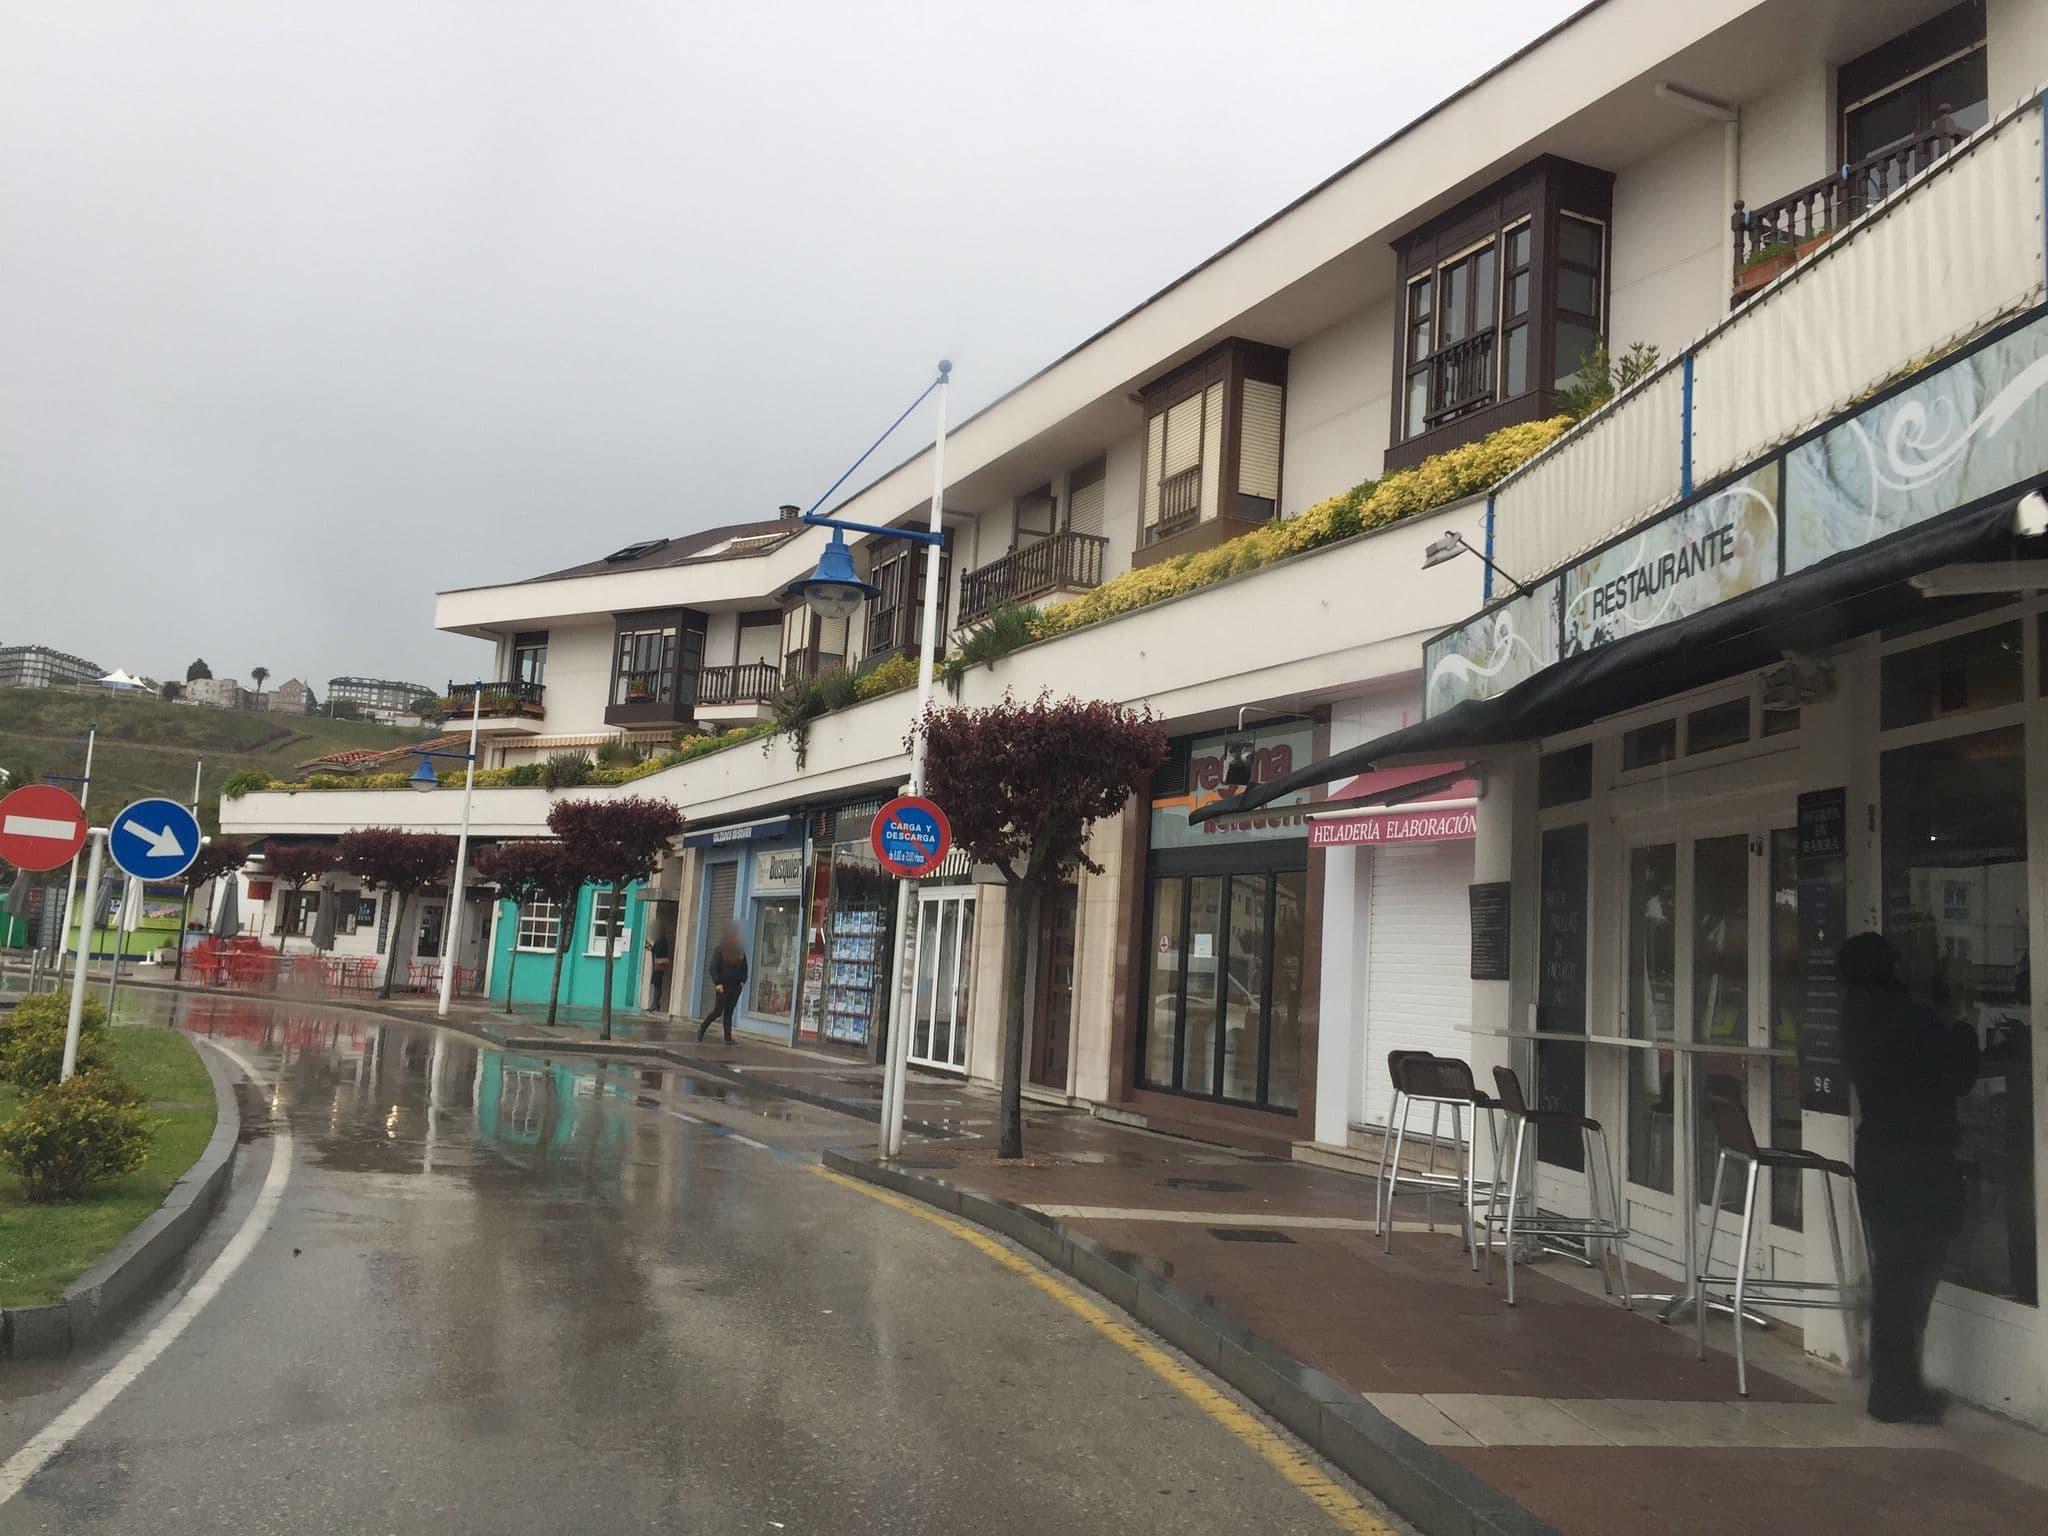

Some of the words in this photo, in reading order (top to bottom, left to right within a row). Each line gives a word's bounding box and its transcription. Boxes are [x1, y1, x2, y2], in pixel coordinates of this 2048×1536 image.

[1593, 522, 1734, 621] RESTAURANTE
[886, 832, 935, 843] DESCARGA
[890, 822, 921, 832] CARGA
[926, 824, 932, 833] Y
[1313, 819, 1380, 843] HELADERÍA
[1386, 812, 1477, 839] ELABORACIÓN
